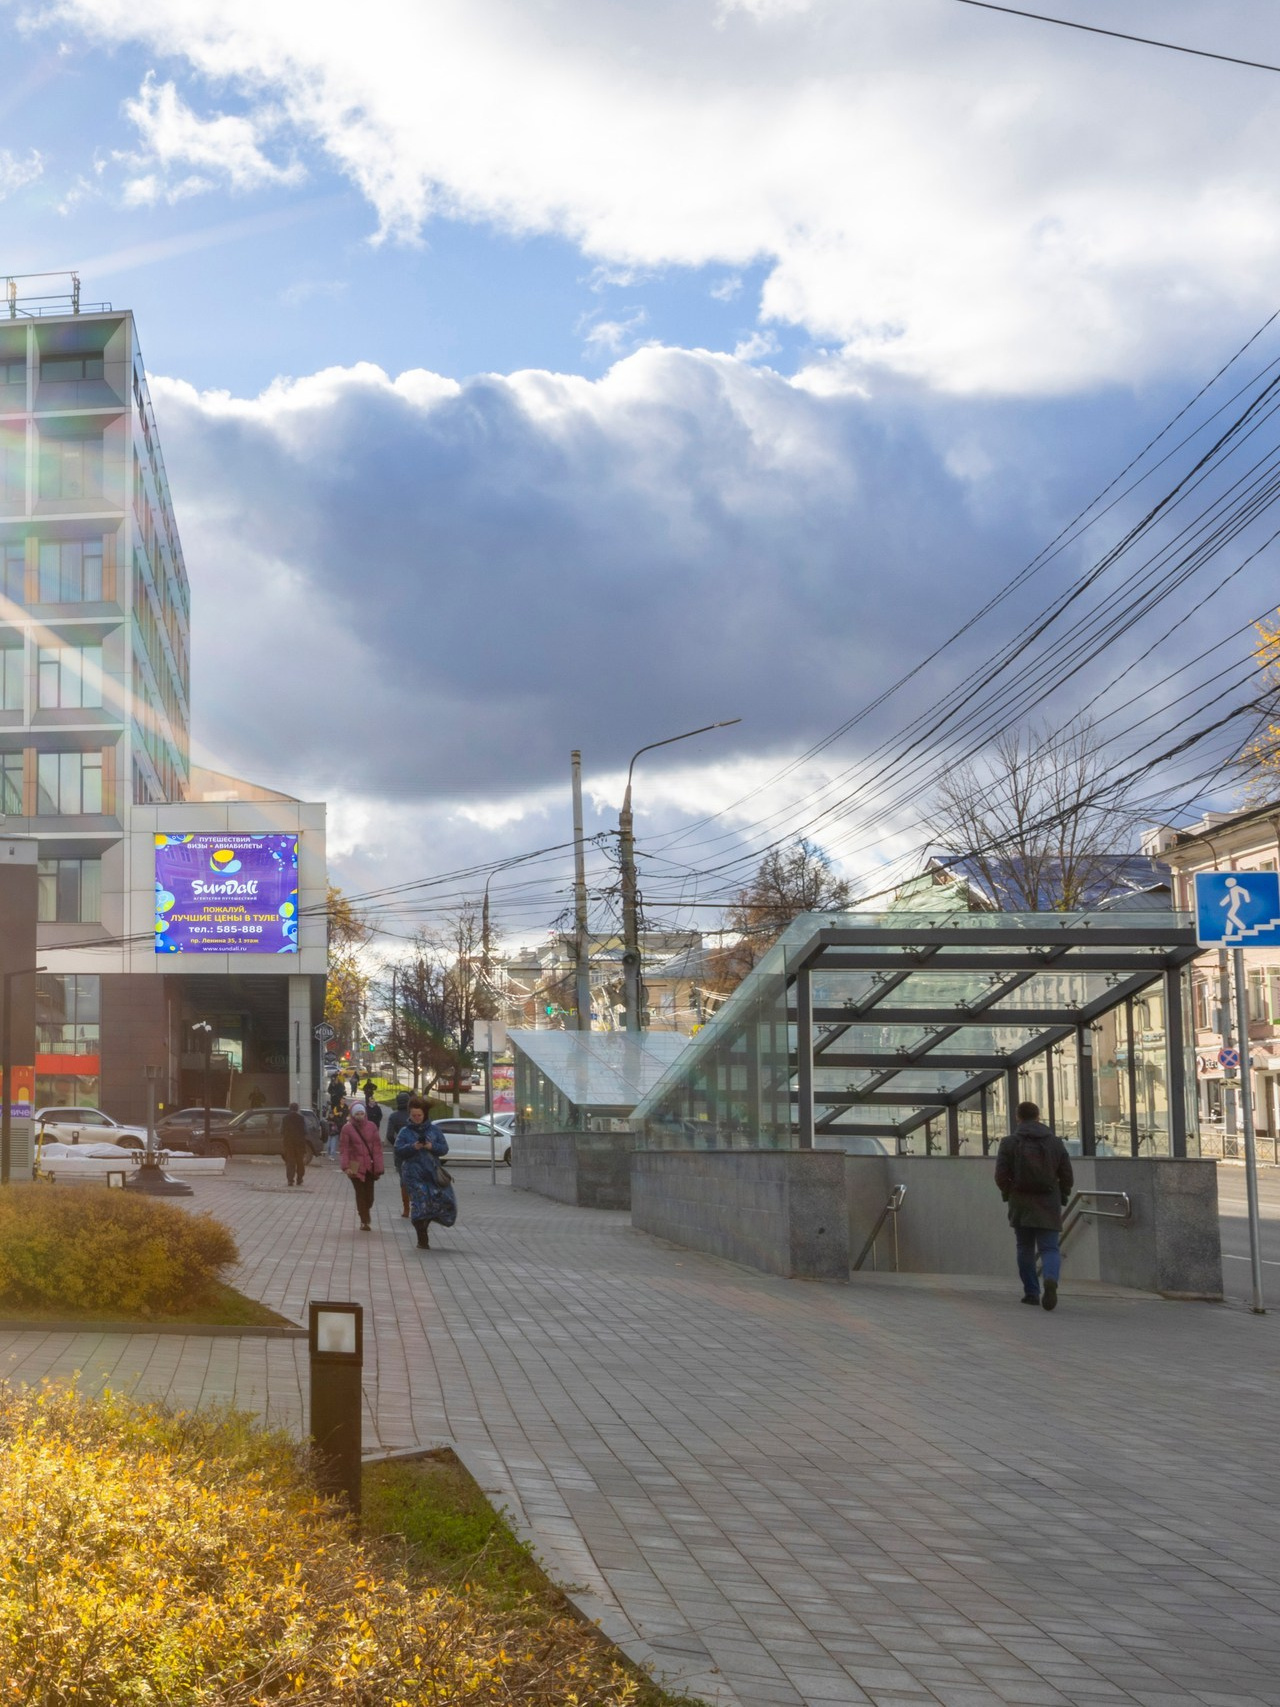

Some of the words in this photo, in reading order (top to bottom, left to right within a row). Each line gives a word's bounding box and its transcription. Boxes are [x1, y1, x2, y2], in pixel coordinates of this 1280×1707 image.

[191, 880, 258, 895] SunDali
[203, 905, 247, 914] ПОЖАЛУЙ,
[214, 914, 242, 922] ЦЕНЫ
